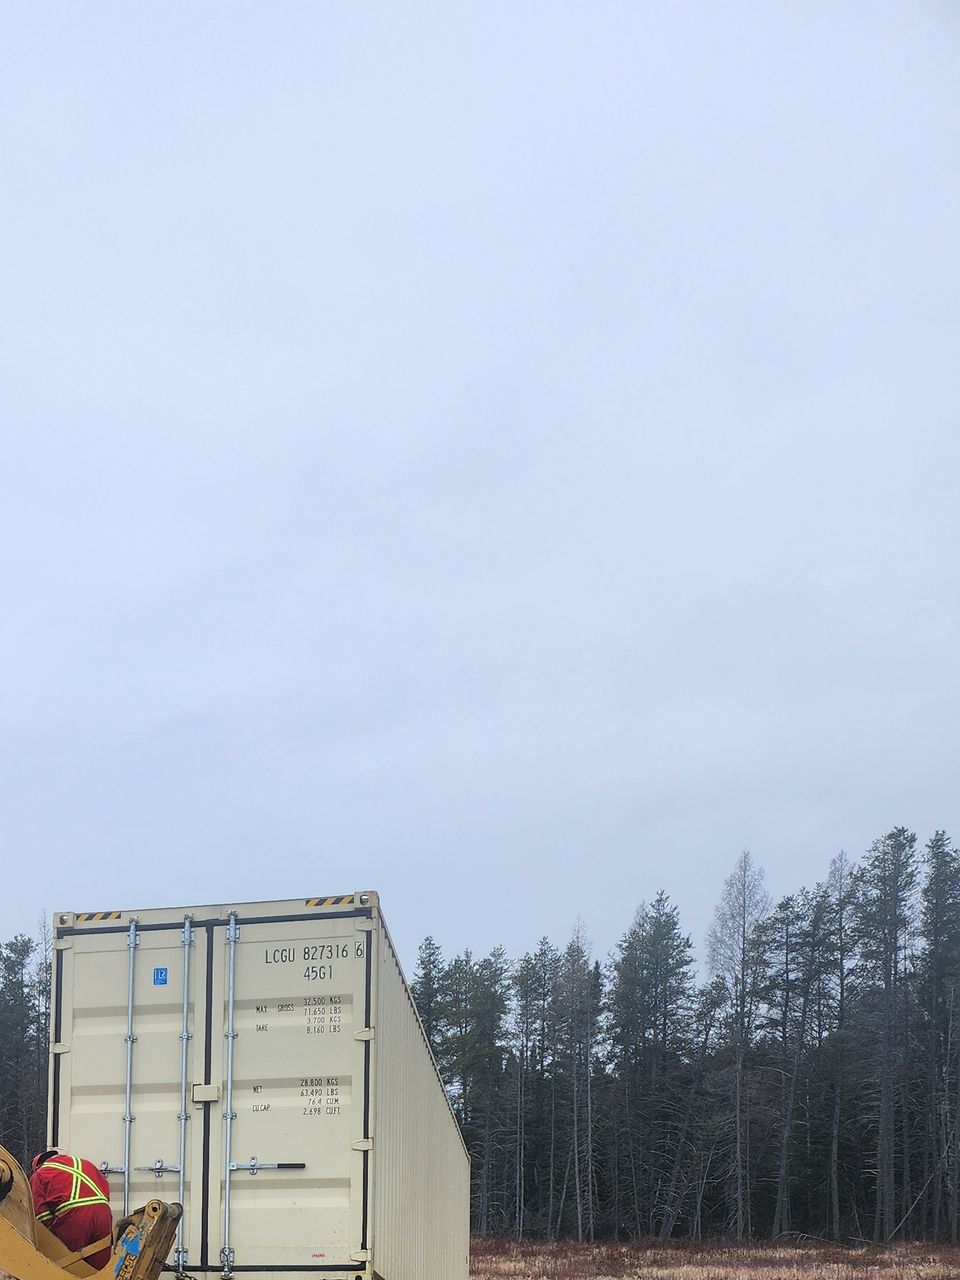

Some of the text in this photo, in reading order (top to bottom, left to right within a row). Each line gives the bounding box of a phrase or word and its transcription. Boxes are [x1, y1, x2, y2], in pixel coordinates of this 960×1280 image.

[265, 943, 363, 964] LCGU 827316 6
[303, 965, 333, 981] 45G1
[277, 1003, 295, 1012] GROSS
[329, 1006, 342, 1015] LBS
[329, 1015, 341, 1023] KGS
[256, 1024, 268, 1032] TARE
[329, 1025, 341, 1033] LBS
[326, 1078, 339, 1086] KGS
[252, 1085, 263, 1094] NET
[326, 1088, 339, 1096] LBS
